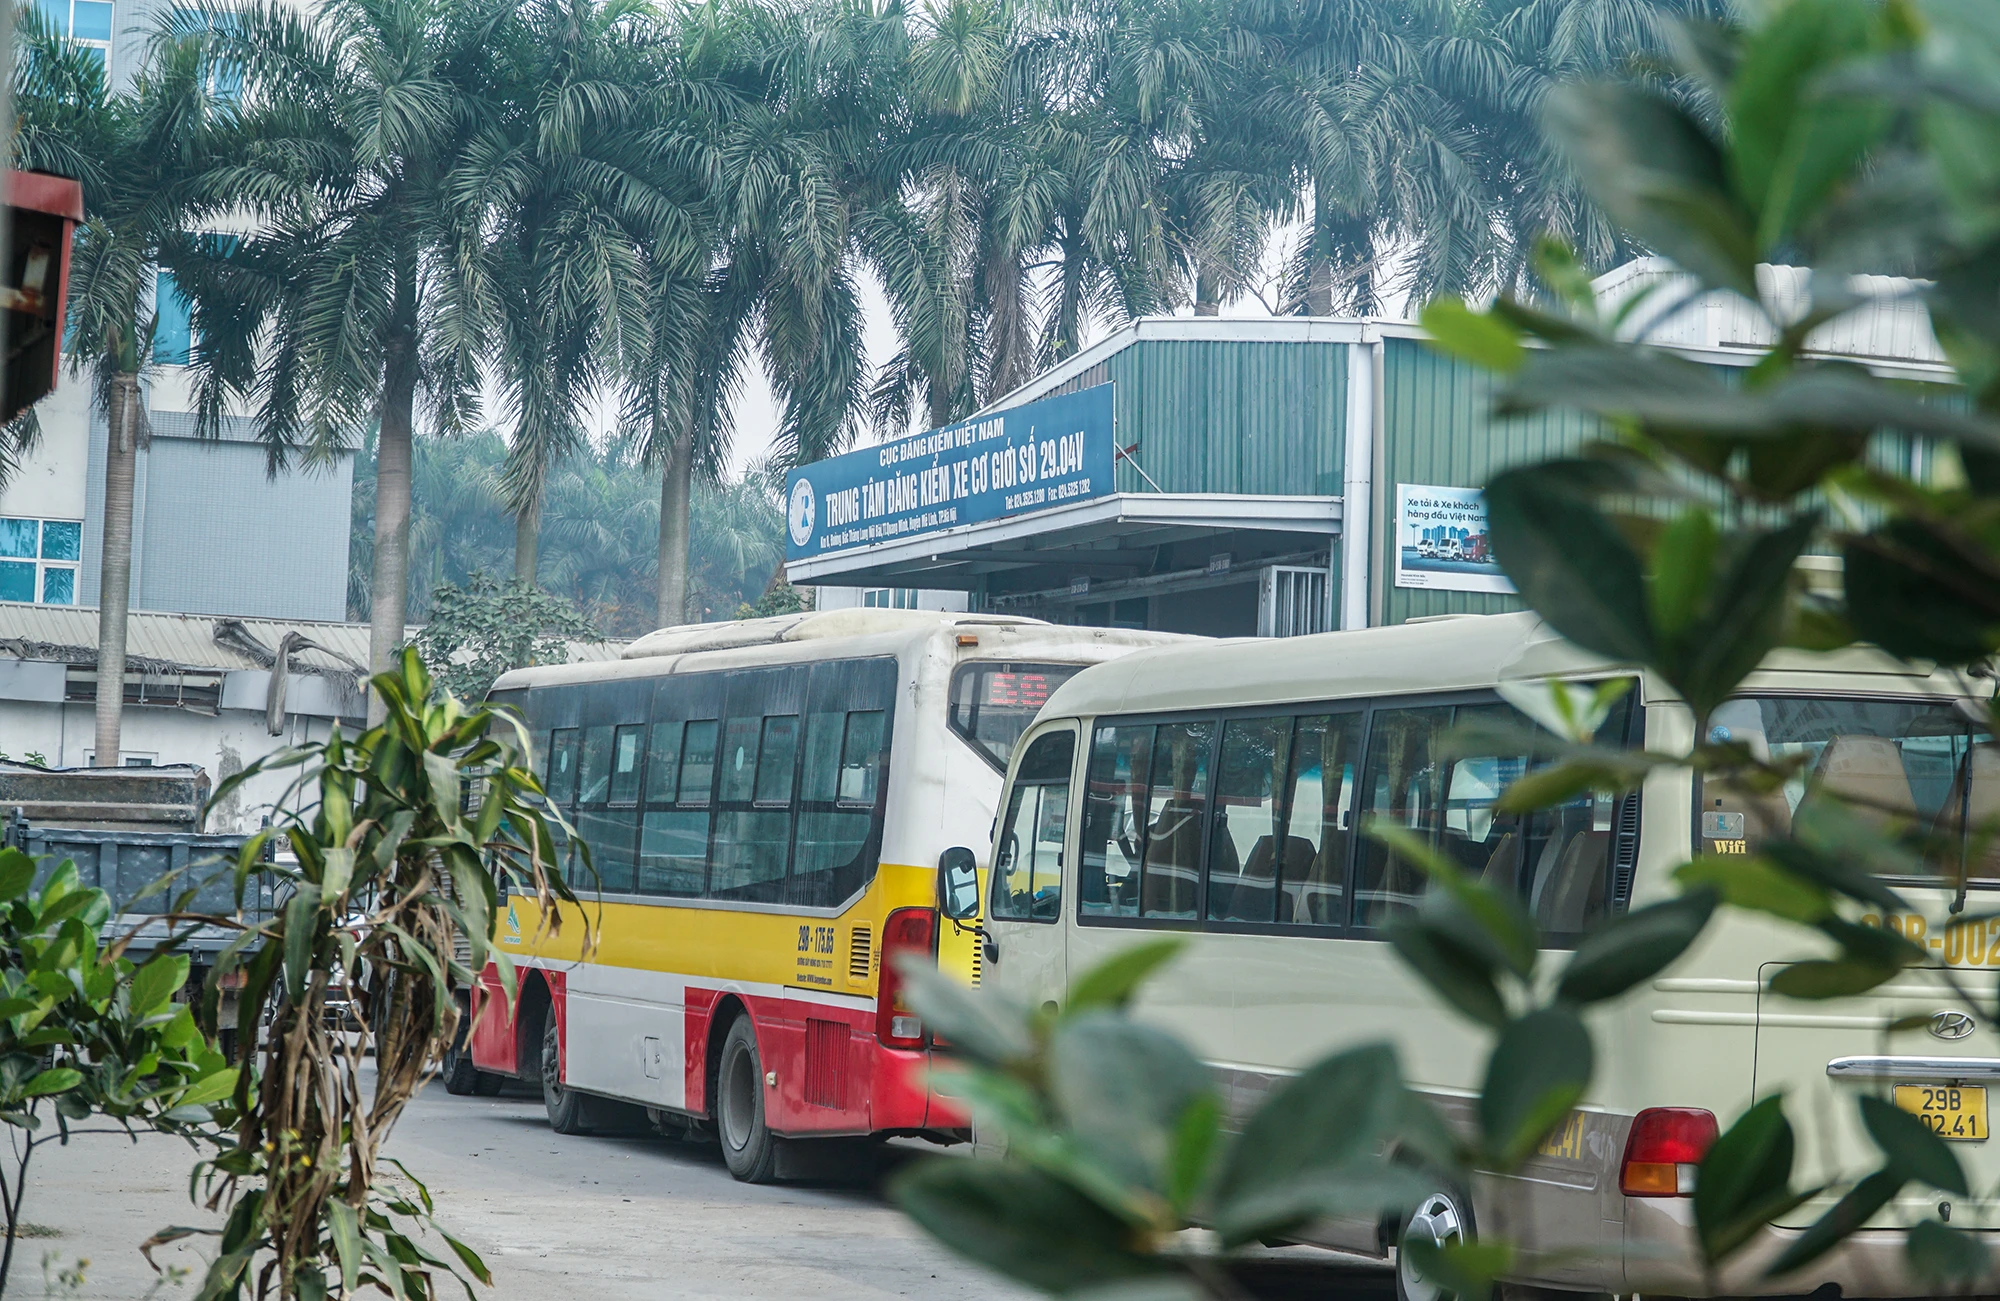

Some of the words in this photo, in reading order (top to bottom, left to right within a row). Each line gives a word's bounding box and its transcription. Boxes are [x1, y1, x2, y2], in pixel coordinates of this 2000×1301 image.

[879, 444, 899, 468] CỤC
[899, 438, 926, 462] ĐĂNG
[928, 426, 953, 455] KIỂM
[954, 421, 977, 448] VIỆT
[978, 417, 1005, 441] NAM
[825, 487, 859, 528] TRUNG
[862, 476, 885, 519] TÂM
[887, 469, 918, 514] ĐĂNG
[920, 453, 950, 507] KIỂM
[952, 460, 969, 499] XE
[971, 451, 988, 495] CƠ
[991, 437, 1017, 490] GIỚI
[1019, 425, 1037, 484] SỐ
[1040, 431, 1084, 479] 29.04V
[1407, 498, 1419, 507] Xe
[1420, 498, 1432, 507] tải
[1433, 500, 1439, 508] &
[1441, 500, 1452, 509] Xe
[1453, 500, 1479, 511] khách
[1407, 510, 1429, 520] hàng
[1431, 509, 1448, 519] đầu
[1449, 512, 1466, 522] Việt
[1714, 840, 1746, 854] Wifi
[1922, 1089, 1961, 1111] 29B
[1909, 1113, 1976, 1136] 02.41
